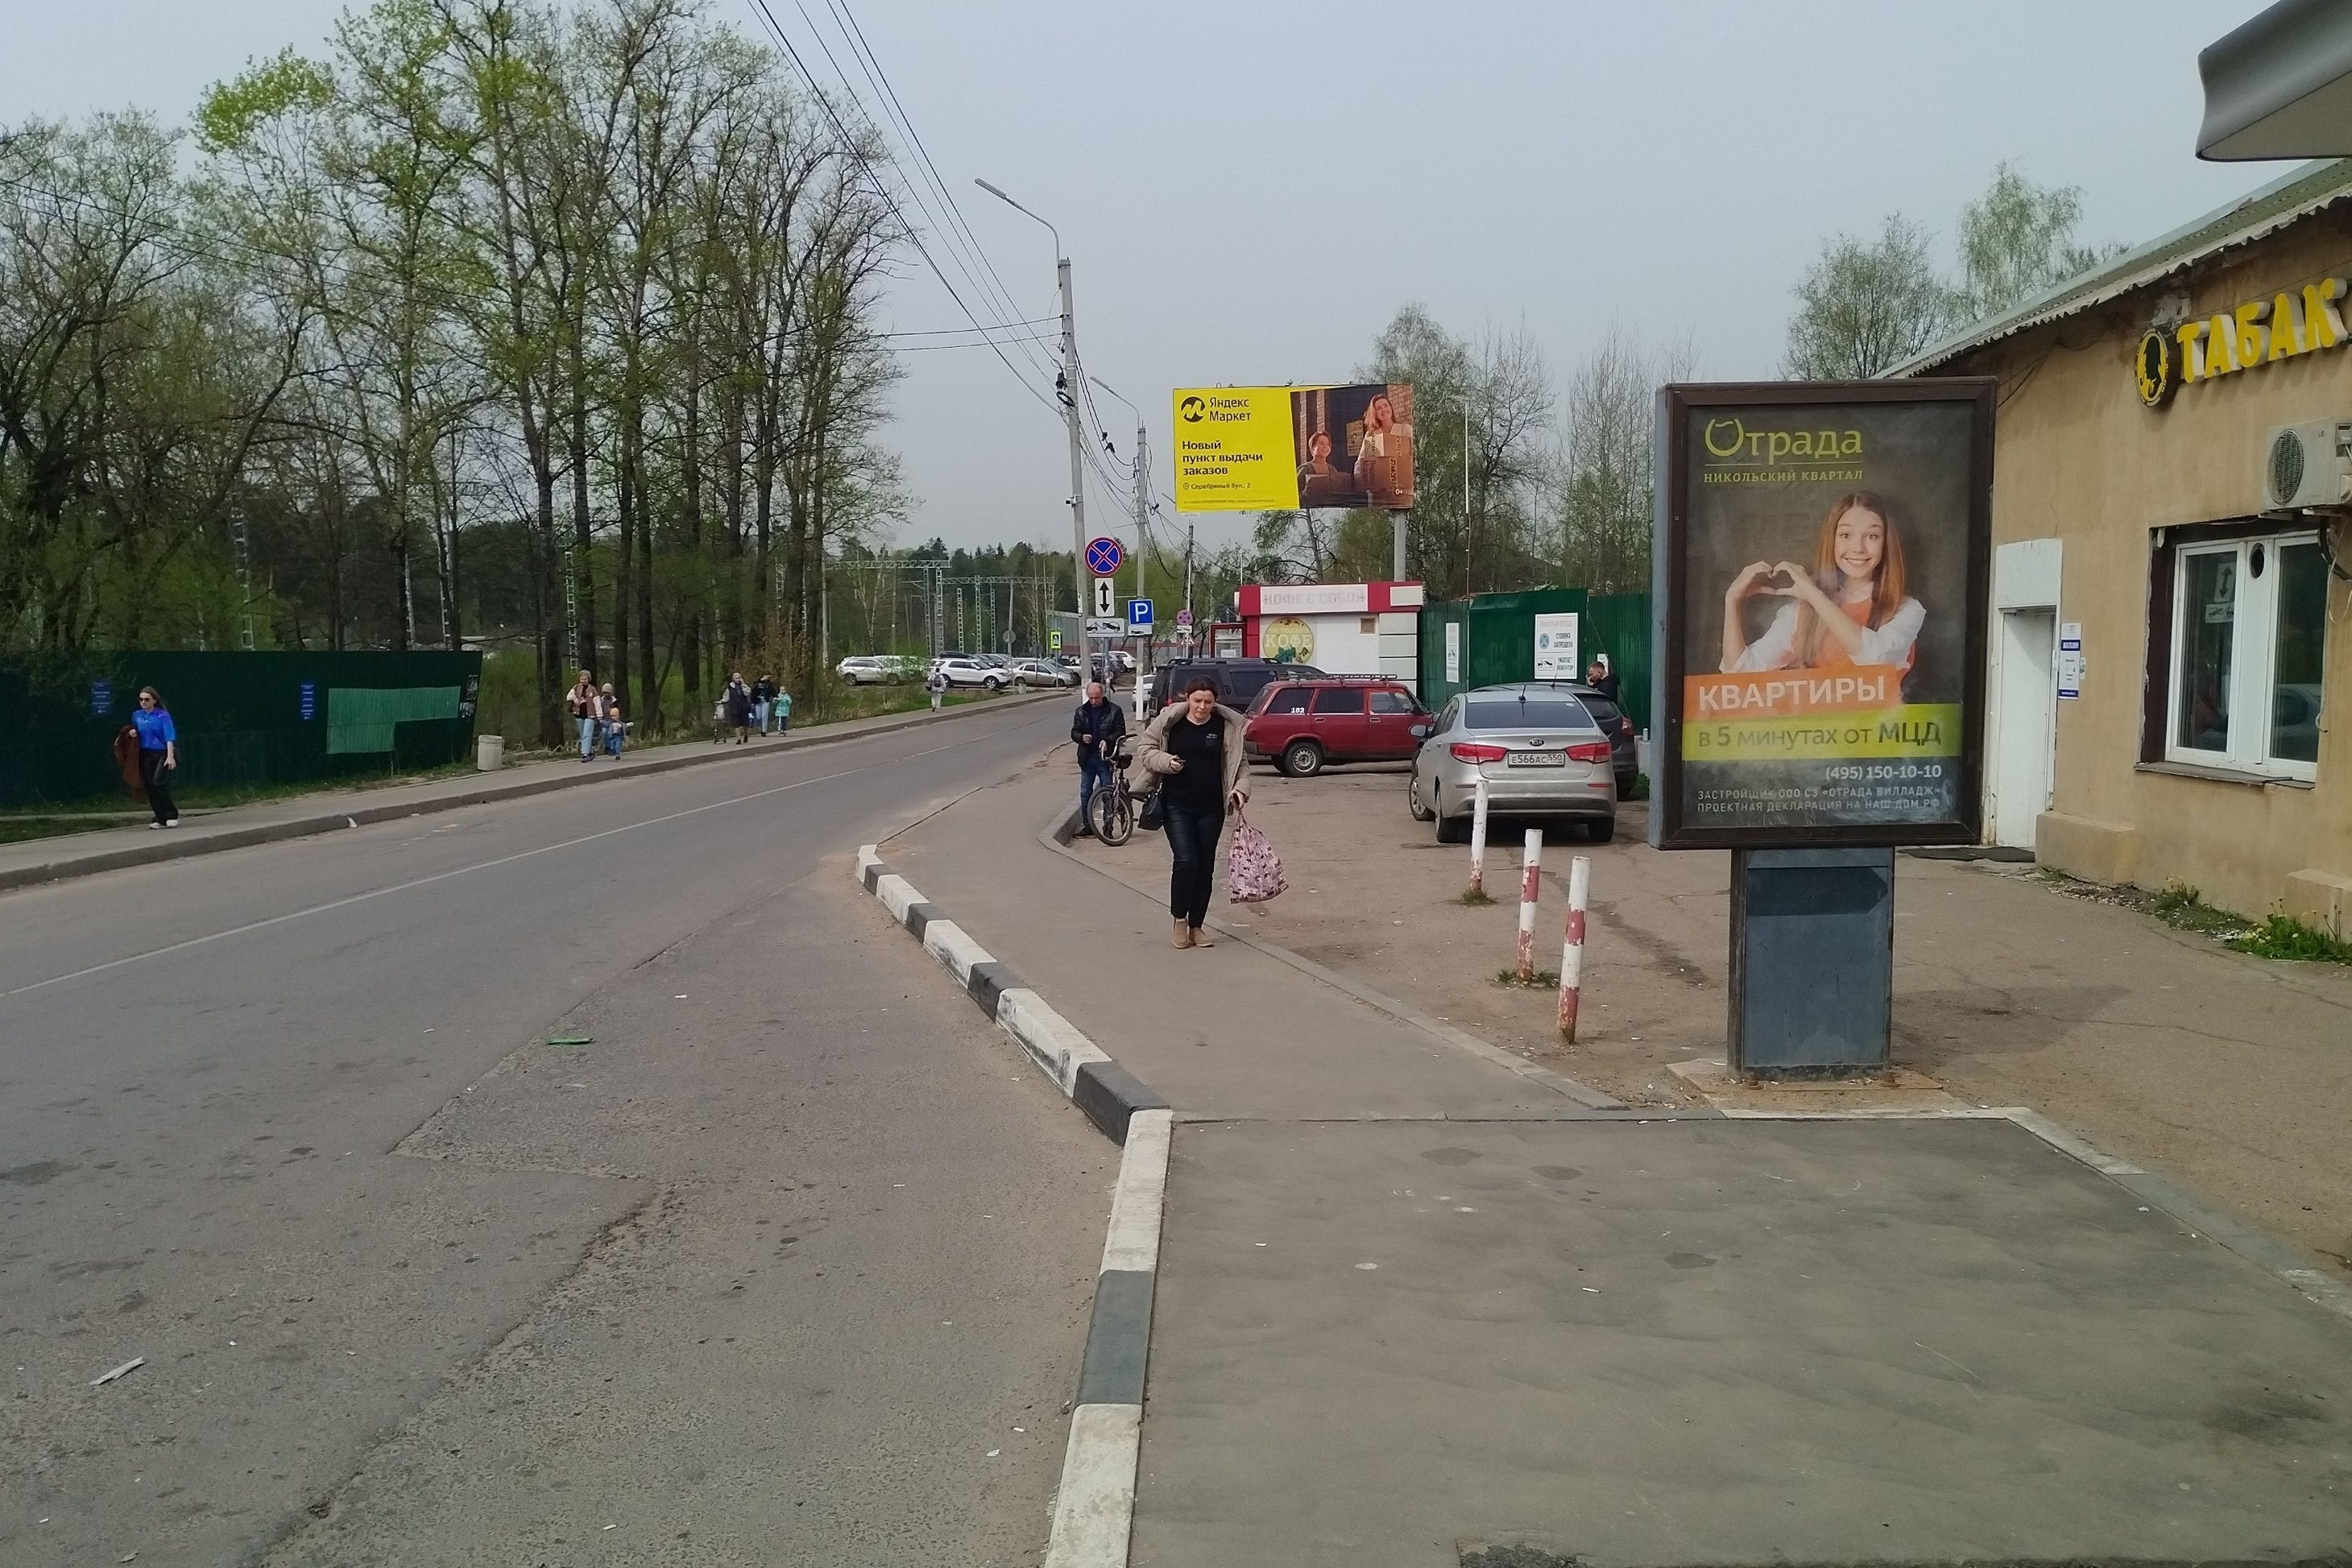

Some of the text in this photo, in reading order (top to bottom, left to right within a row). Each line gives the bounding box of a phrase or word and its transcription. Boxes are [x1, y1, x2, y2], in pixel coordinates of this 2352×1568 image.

[2176, 277, 2342, 383] ТАБАК
[1209, 396, 1249, 409] Яндекс
[1209, 410, 1251, 424] Маркет
[1182, 440, 1222, 450] Новый
[1704, 418, 1863, 465] Отрада
[1182, 453, 1264, 465] пункт выдачи
[1182, 466, 1228, 476] заказов
[1704, 470, 1863, 483] НИКОЛЬСКИЙ КВАРТАЛ
[1135, 602, 1149, 623] P
[1265, 633, 1313, 649] КОФЕ
[1699, 676, 1885, 711] КВАРТИРЫ
[1699, 722, 1942, 750] в 5 минутах от МЦД
[1825, 764, 1942, 780] (495) 150-10-10
[1778, 788, 1800, 798] ООО
[1822, 787, 1873, 798] «ОТРАДА
[1877, 786, 1941, 797] ВИЛЛАДЖ»
[1697, 801, 1762, 813] ПРОЕКТНАЯ
[1766, 800, 1842, 813] ДЕКЛАРАЦИЯ
[1845, 800, 1861, 809] НА
